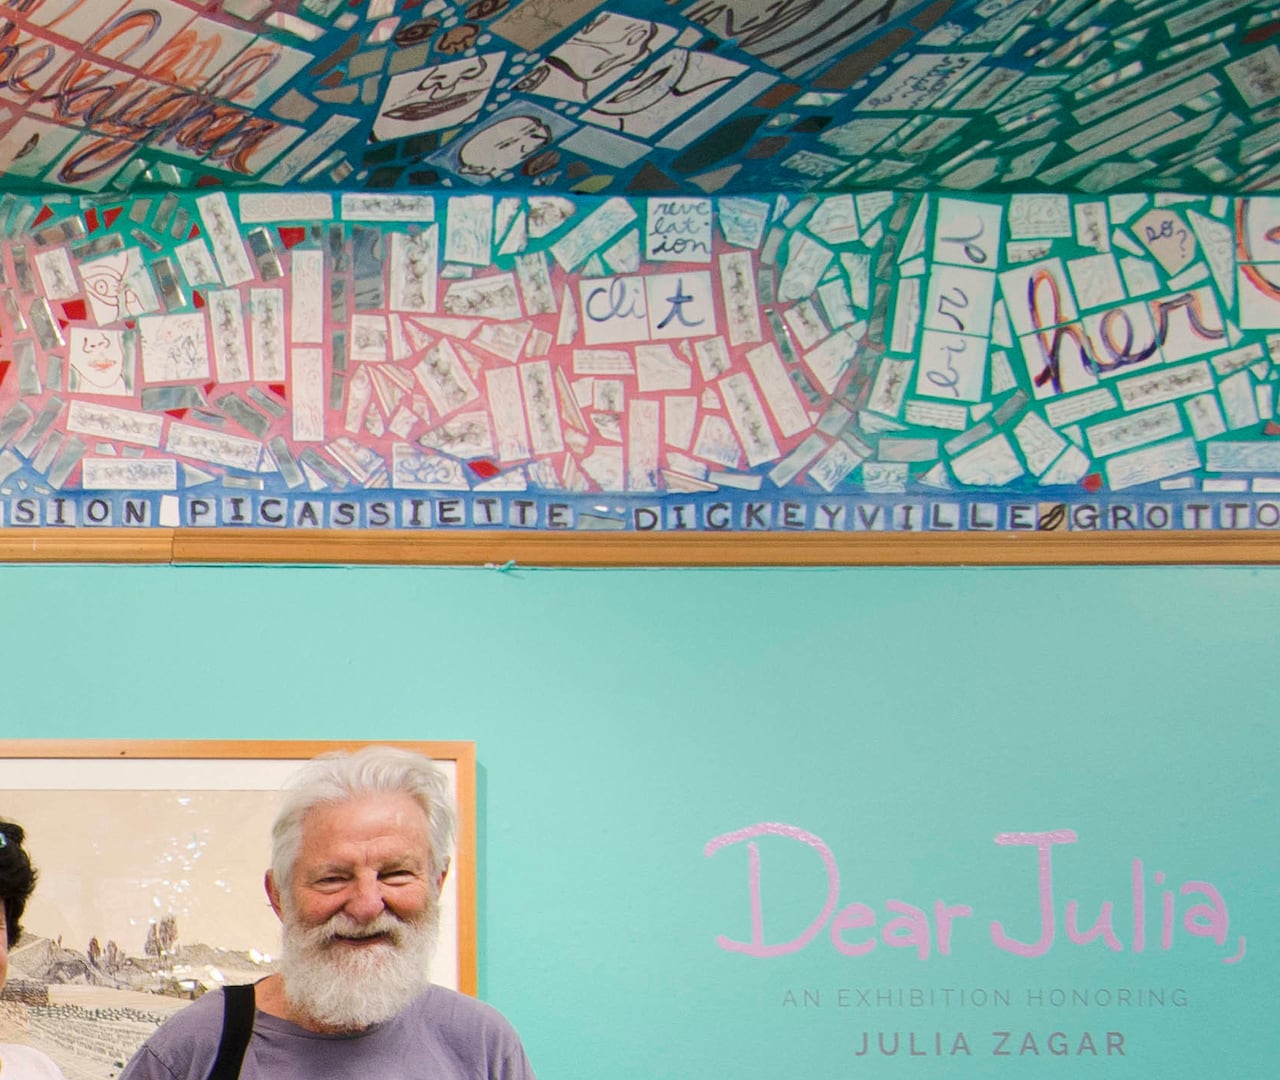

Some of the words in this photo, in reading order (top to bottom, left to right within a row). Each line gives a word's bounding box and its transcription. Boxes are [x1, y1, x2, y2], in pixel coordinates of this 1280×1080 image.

[586, 277, 705, 329] clit
[1029, 269, 1225, 394] her
[191, 497, 569, 528] PICASSIETTE
[635, 503, 1033, 530] DICKEYVILLE
[1073, 503, 1280, 530] GROTTO
[704, 822, 972, 960] Dear
[991, 828, 1247, 964] Julia,
[783, 989, 821, 1008] AN
[838, 989, 1010, 1008] EXHIBITION
[1028, 989, 1190, 1008] HONORING
[855, 1032, 972, 1056] JULIA
[993, 1032, 1127, 1056] ZAGAR
